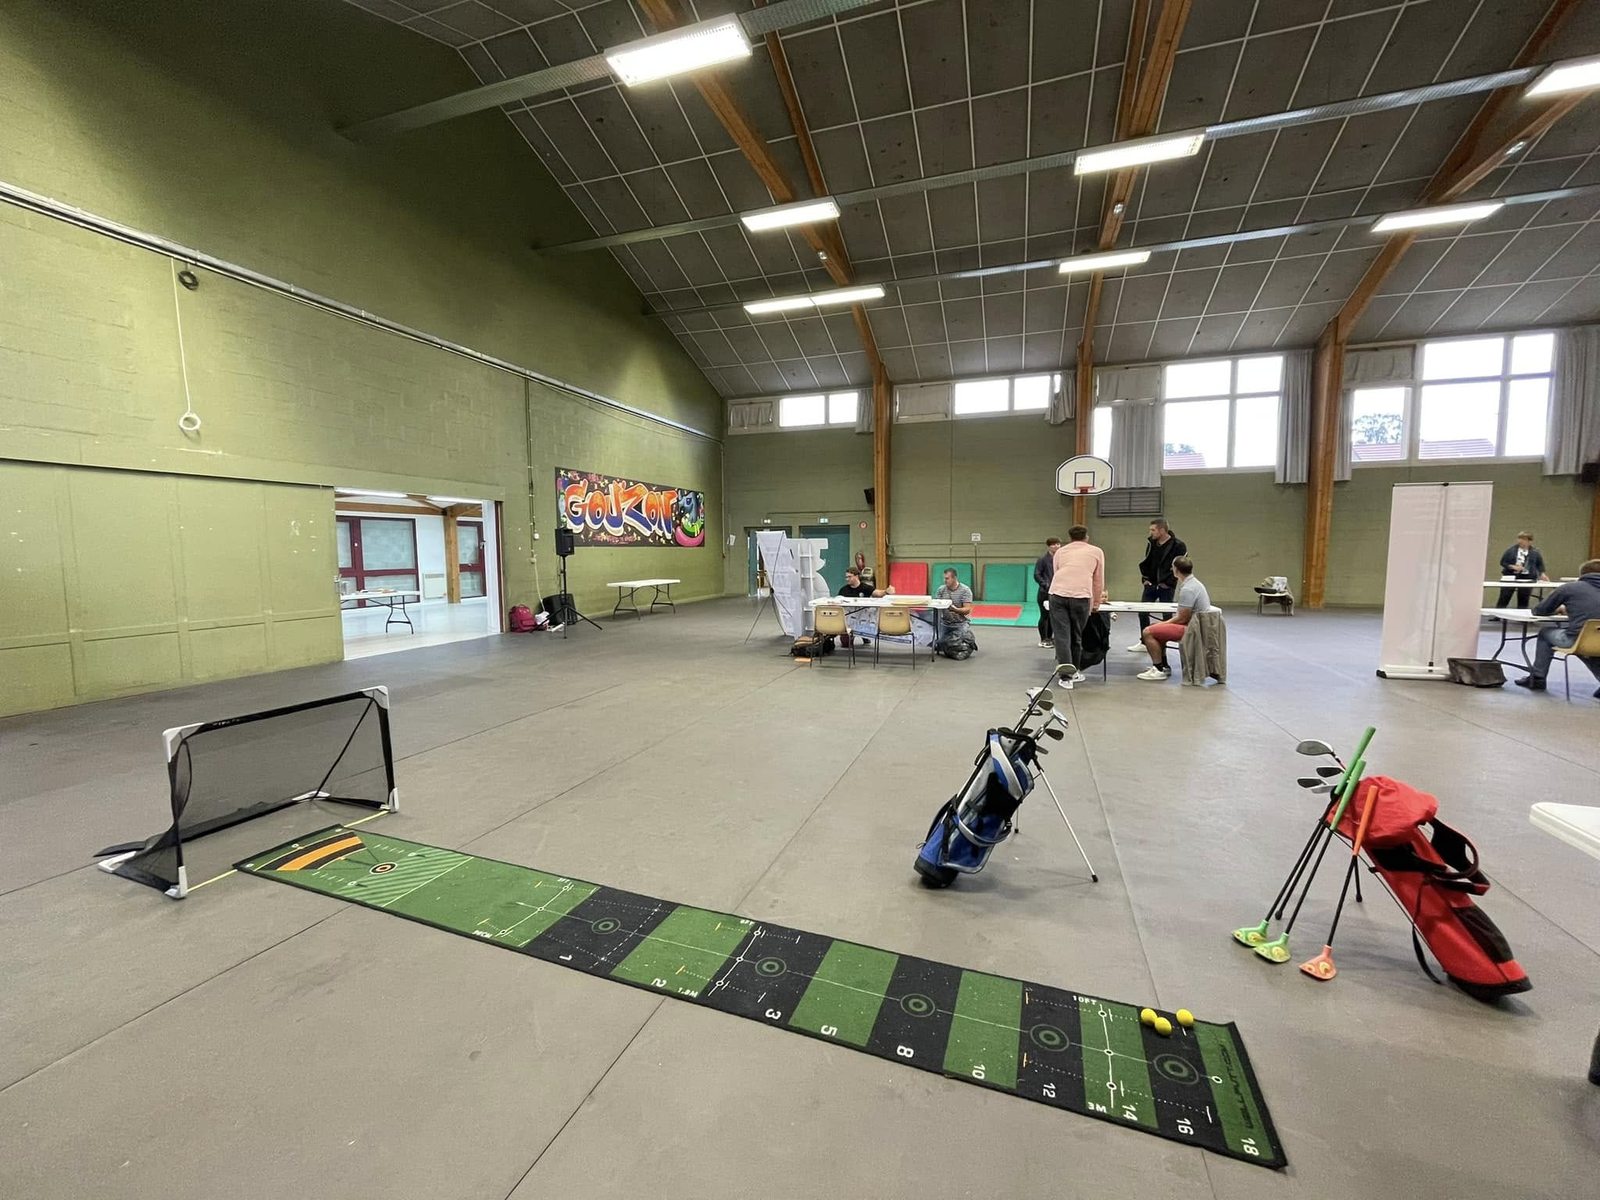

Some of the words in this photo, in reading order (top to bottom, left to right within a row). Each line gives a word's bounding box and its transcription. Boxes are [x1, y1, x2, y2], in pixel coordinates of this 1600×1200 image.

[651, 978, 667, 988] 2
[765, 1008, 781, 1020] 3
[820, 1024, 838, 1037] 5
[896, 1044, 915, 1058] 8
[972, 1064, 985, 1080] 10
[1042, 1082, 1056, 1098] 12
[1121, 1104, 1138, 1121] 14
[1176, 1117, 1194, 1135] 16
[1240, 1137, 1259, 1156] 18
